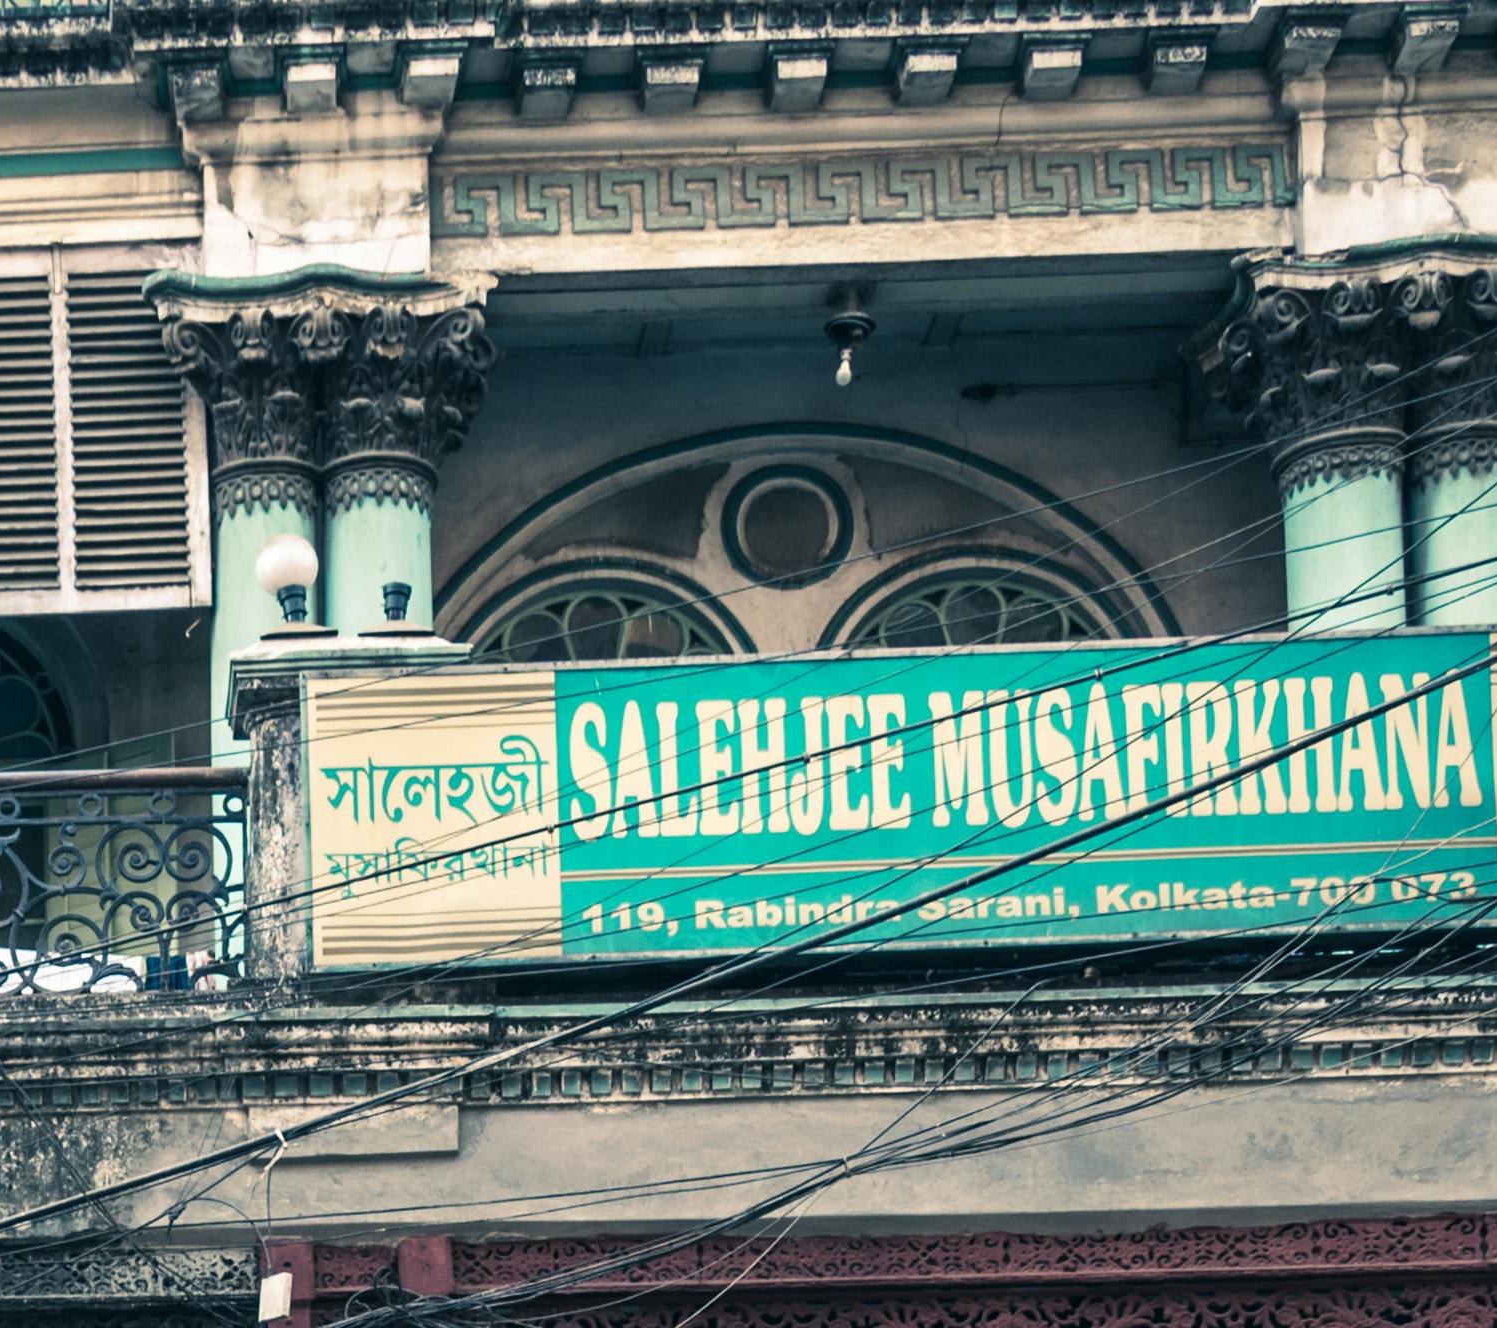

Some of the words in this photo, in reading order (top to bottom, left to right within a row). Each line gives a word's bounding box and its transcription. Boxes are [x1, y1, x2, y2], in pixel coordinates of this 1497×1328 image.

[320, 735, 550, 826] সালেহজী
[569, 692, 912, 842] SALEHJEE
[927, 668, 1482, 829] MUSAFIRKHANA
[582, 900, 679, 937] 119,
[695, 894, 902, 930] Rabindra
[917, 883, 1081, 922] Sarani,
[1394, 871, 1476, 903] 073
